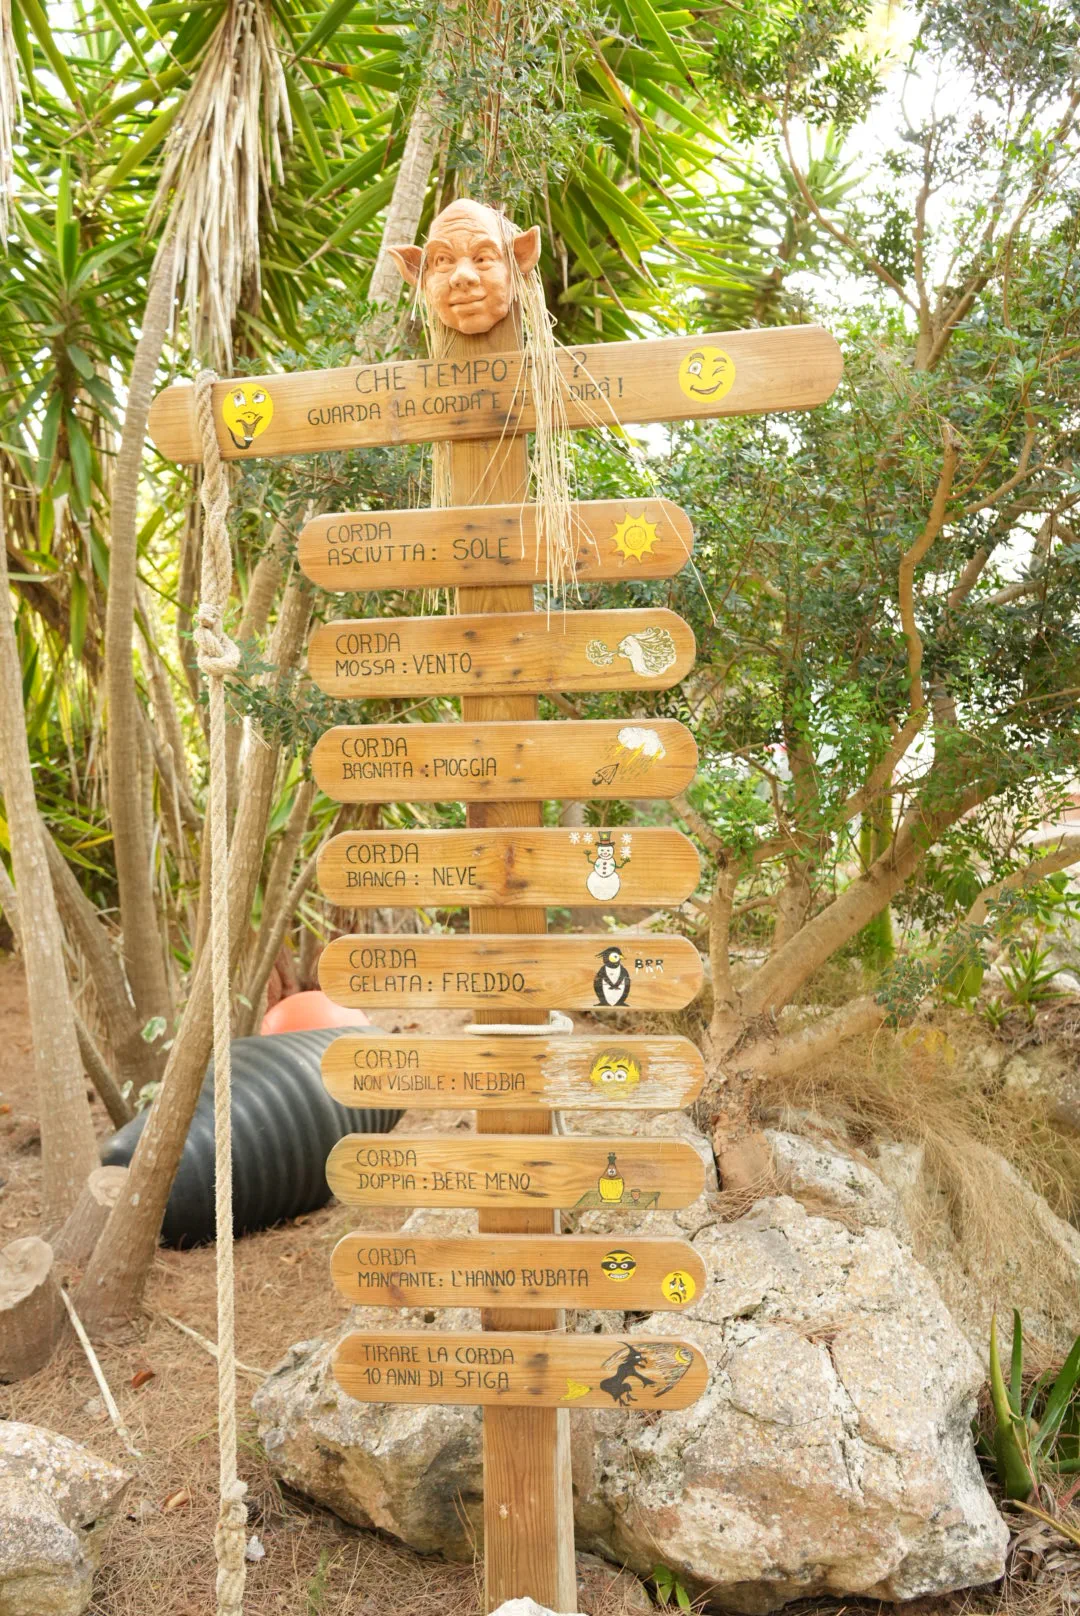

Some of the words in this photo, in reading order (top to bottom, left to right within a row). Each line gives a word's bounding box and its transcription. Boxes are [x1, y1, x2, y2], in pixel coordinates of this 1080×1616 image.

[355, 365, 406, 394] CHE
[417, 358, 507, 389] TEMPO
[307, 402, 381, 426] GUARDA
[397, 399, 416, 418] LA
[422, 393, 481, 415] CORDA
[492, 391, 501, 409] E
[326, 521, 392, 544] CORDA
[327, 543, 436, 567] ASCIUTTA:
[452, 537, 512, 561] SOLE
[335, 632, 400, 655] CORDA
[412, 652, 472, 675] VENTO
[341, 737, 408, 758] CORDA
[433, 757, 497, 777] PIOGGIA
[345, 842, 419, 864] CORDA
[432, 866, 477, 887] NEVE
[349, 948, 417, 969] CORDA
[634, 958, 664, 974] BRR
[442, 972, 525, 993] FREDDO
[353, 1049, 420, 1069] CORDA
[353, 1074, 382, 1092] NON
[463, 1071, 526, 1092] NEBBIA
[356, 1148, 417, 1168] CORDA
[431, 1171, 477, 1191] BERE
[485, 1172, 531, 1191] MENO
[357, 1248, 417, 1266] CORDA
[451, 1269, 516, 1288] L'HANNO
[521, 1268, 589, 1288] RUBATA
[361, 1344, 421, 1363] TIRARE
[427, 1346, 448, 1364] LA
[455, 1347, 515, 1365] CORDA
[362, 1367, 382, 1385] 10
[386, 1368, 421, 1387] ANNI
[427, 1370, 444, 1387] DI
[454, 1370, 509, 1389] SFIGA
